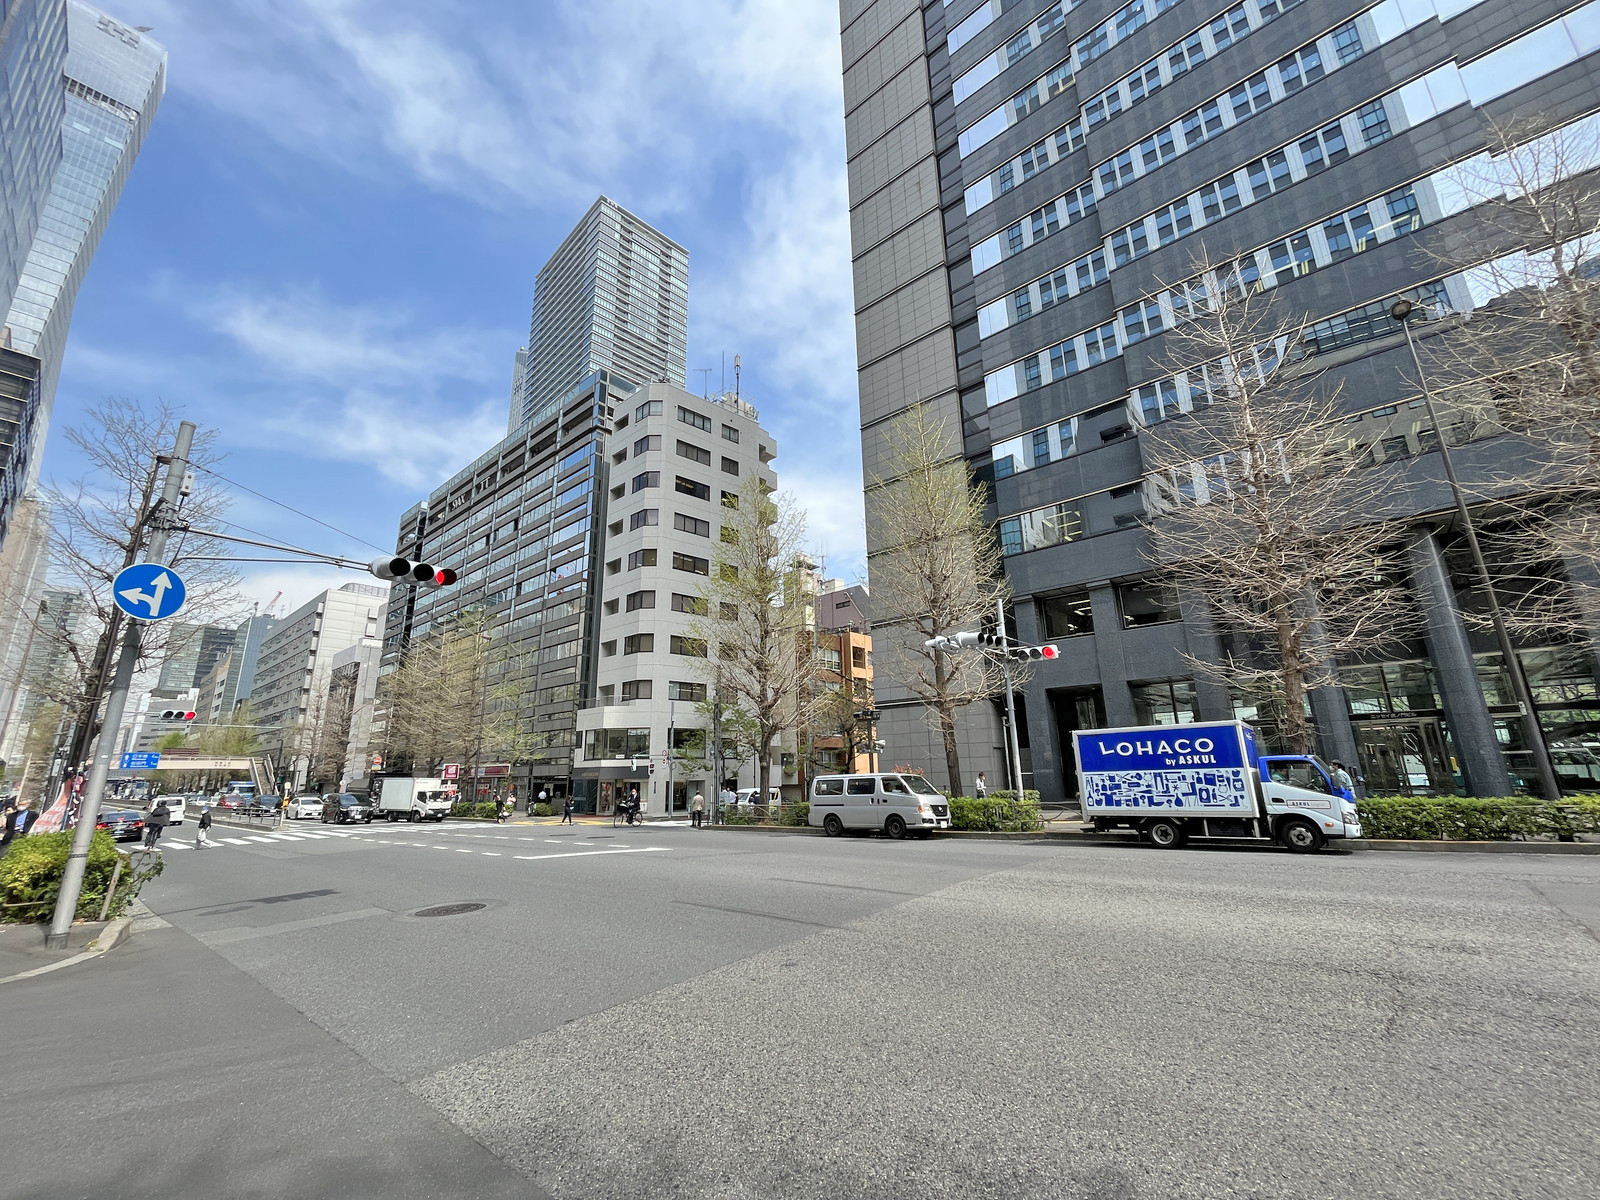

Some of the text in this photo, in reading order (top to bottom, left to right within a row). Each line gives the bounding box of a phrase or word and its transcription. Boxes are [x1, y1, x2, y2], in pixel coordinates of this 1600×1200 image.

[1098, 738, 1214, 756] LOHACO
[1165, 754, 1217, 766] by ASKUL
